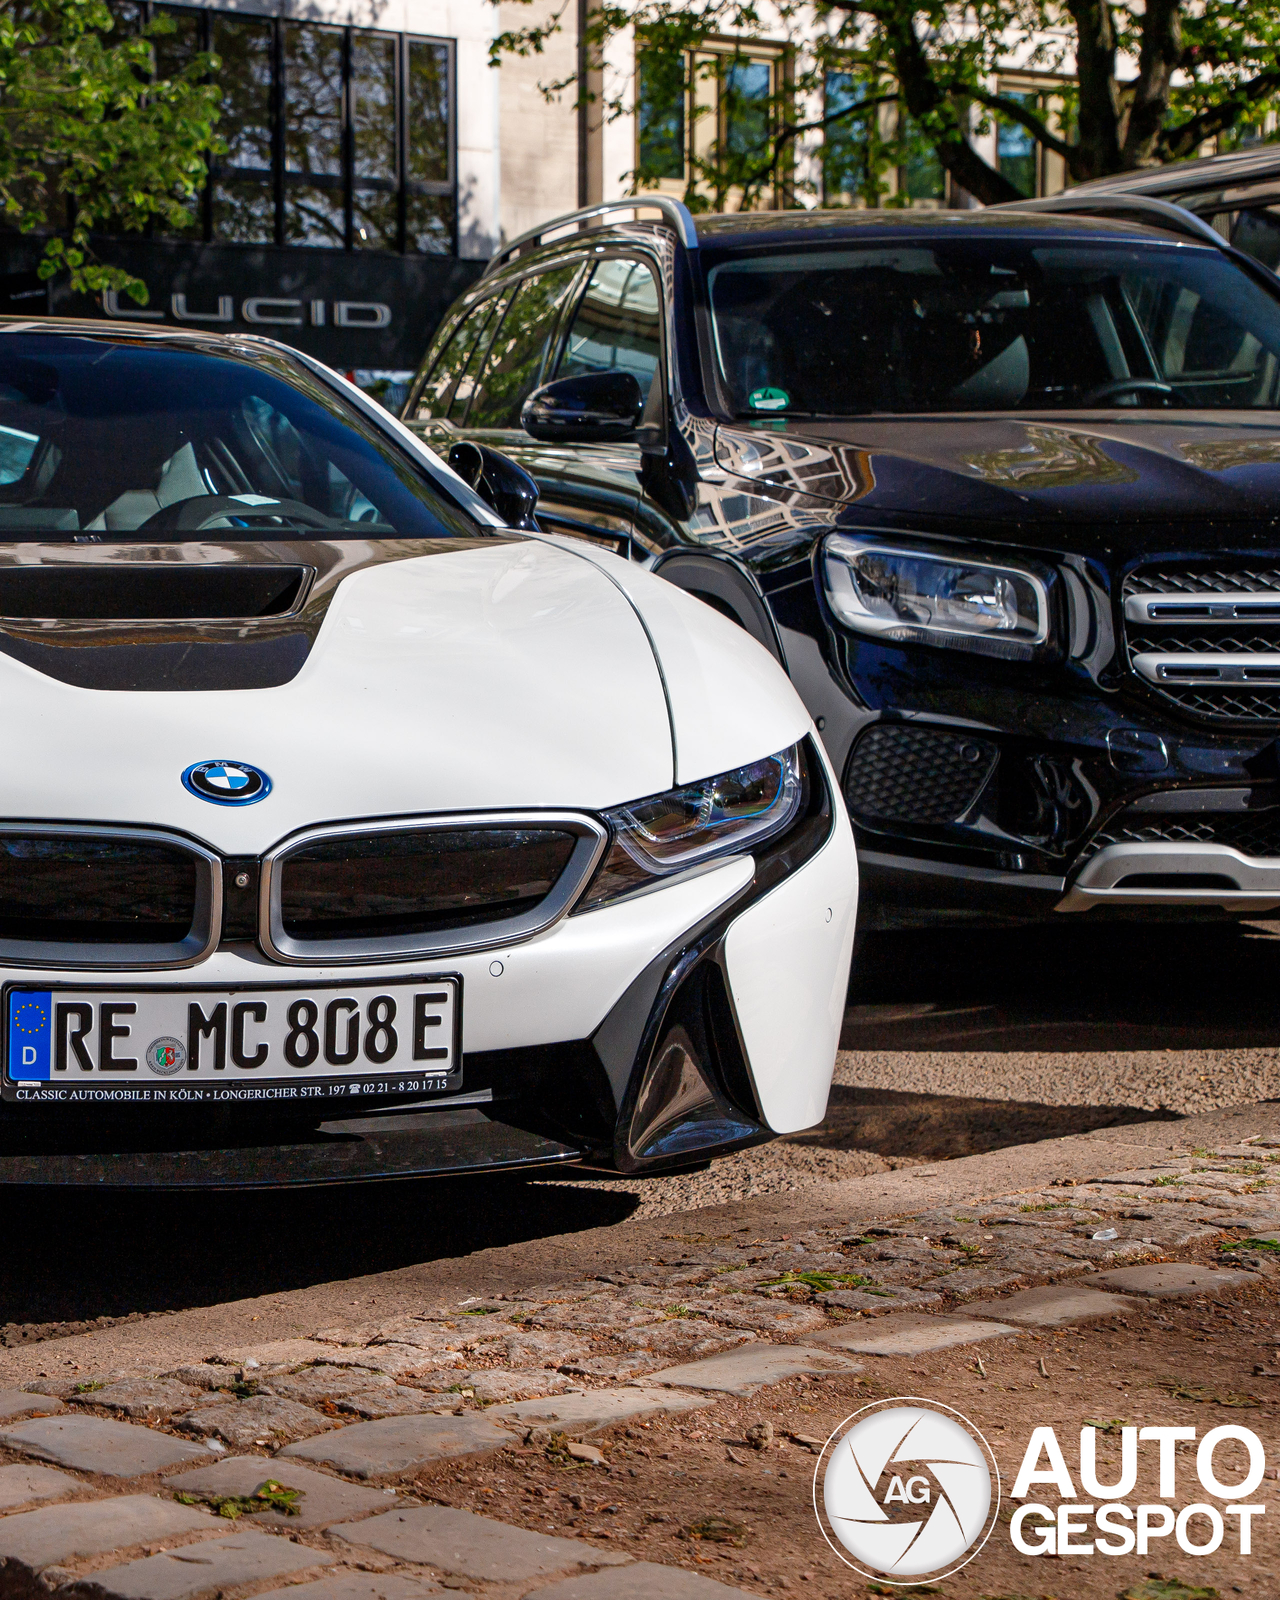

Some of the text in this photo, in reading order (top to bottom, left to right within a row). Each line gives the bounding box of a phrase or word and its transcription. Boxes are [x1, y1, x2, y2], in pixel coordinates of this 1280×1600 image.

[102, 290, 392, 328] LUCID
[195, 762, 253, 773] BMW
[22, 992, 449, 1071] D RE MC 808 E
[16, 1089, 67, 1100] CLASSIC
[69, 1090, 151, 1100] AUTOMOBILE
[154, 1090, 167, 1100] IN
[169, 1088, 203, 1100] KÖLN
[213, 1088, 297, 1100] LONGERICHER
[301, 1086, 324, 1097] STR.
[329, 1085, 346, 1095] 197
[363, 1083, 375, 1093] 02
[377, 1082, 389, 1092] 21
[398, 1080, 405, 1091] 8
[407, 1080, 419, 1090] 20
[422, 1079, 433, 1090] 17
[436, 1078, 448, 1089] 15
